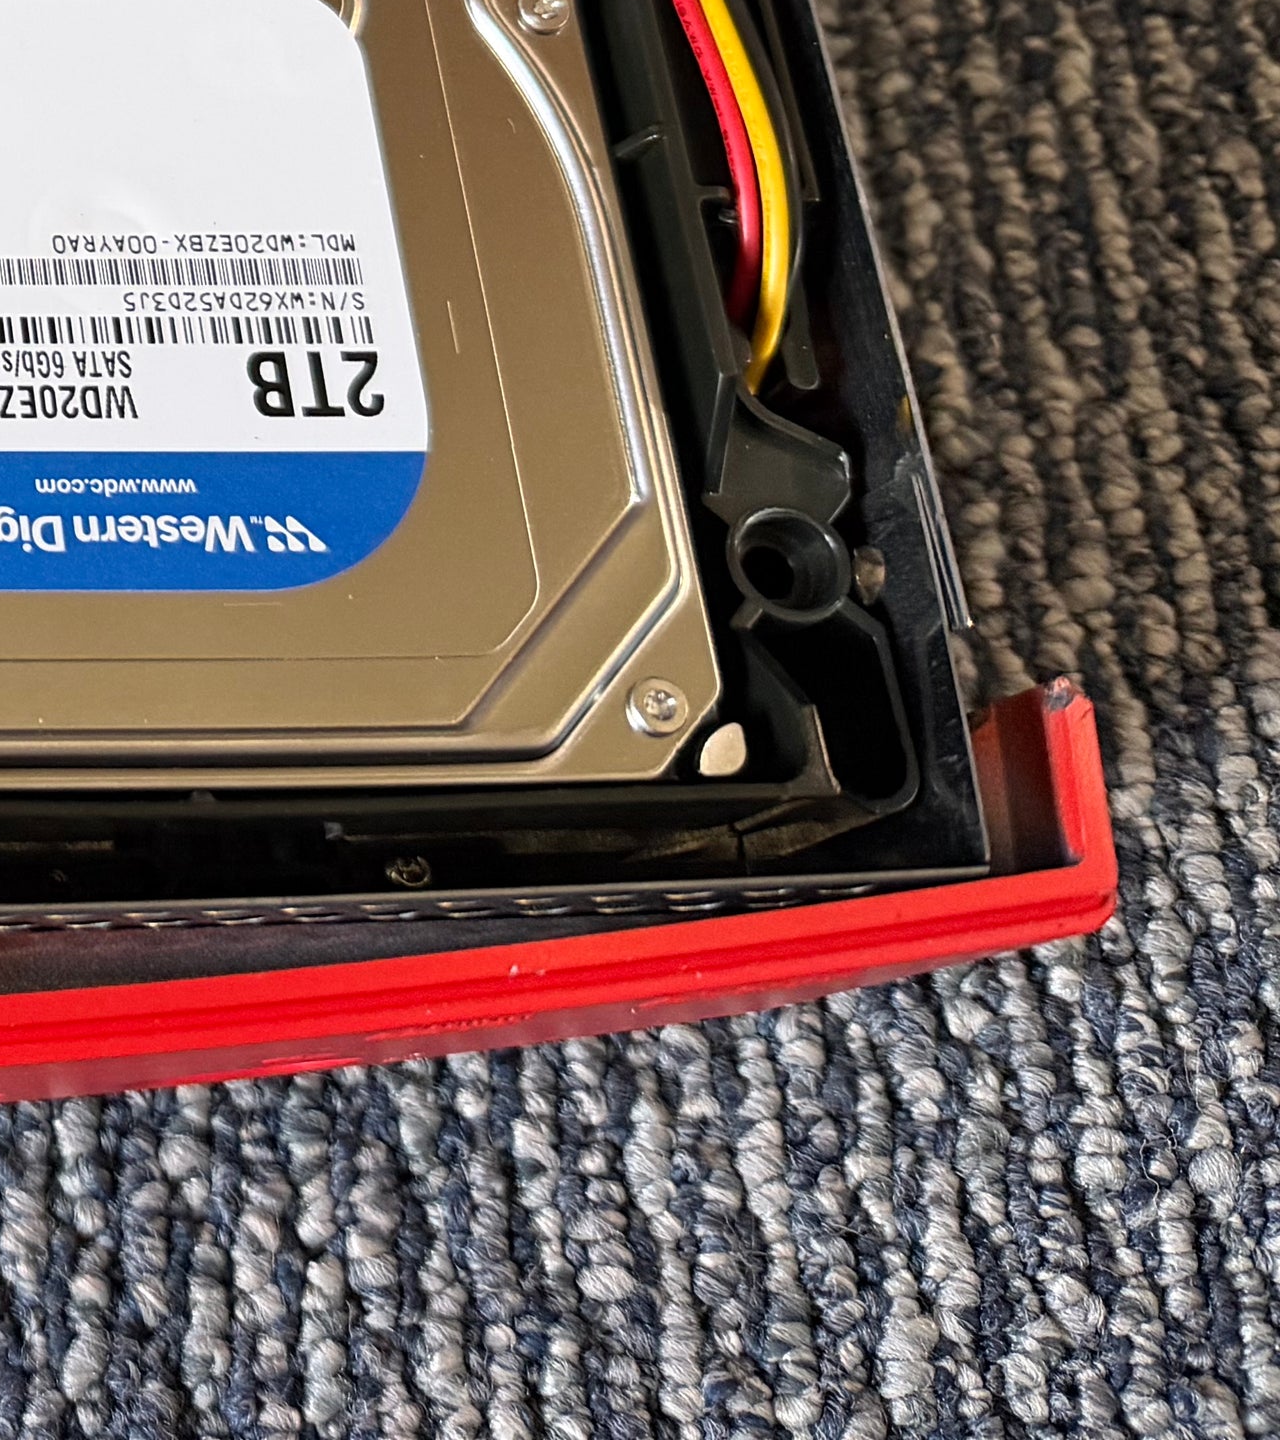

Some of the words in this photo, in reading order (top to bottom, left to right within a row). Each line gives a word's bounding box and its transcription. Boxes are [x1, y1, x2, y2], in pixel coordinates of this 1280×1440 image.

[2, 350, 64, 378] 6Gb/s
[72, 351, 131, 378] SATA
[247, 352, 384, 417] 2TB
[35, 479, 197, 497] www.wdc.com
[73, 515, 254, 552] Western
